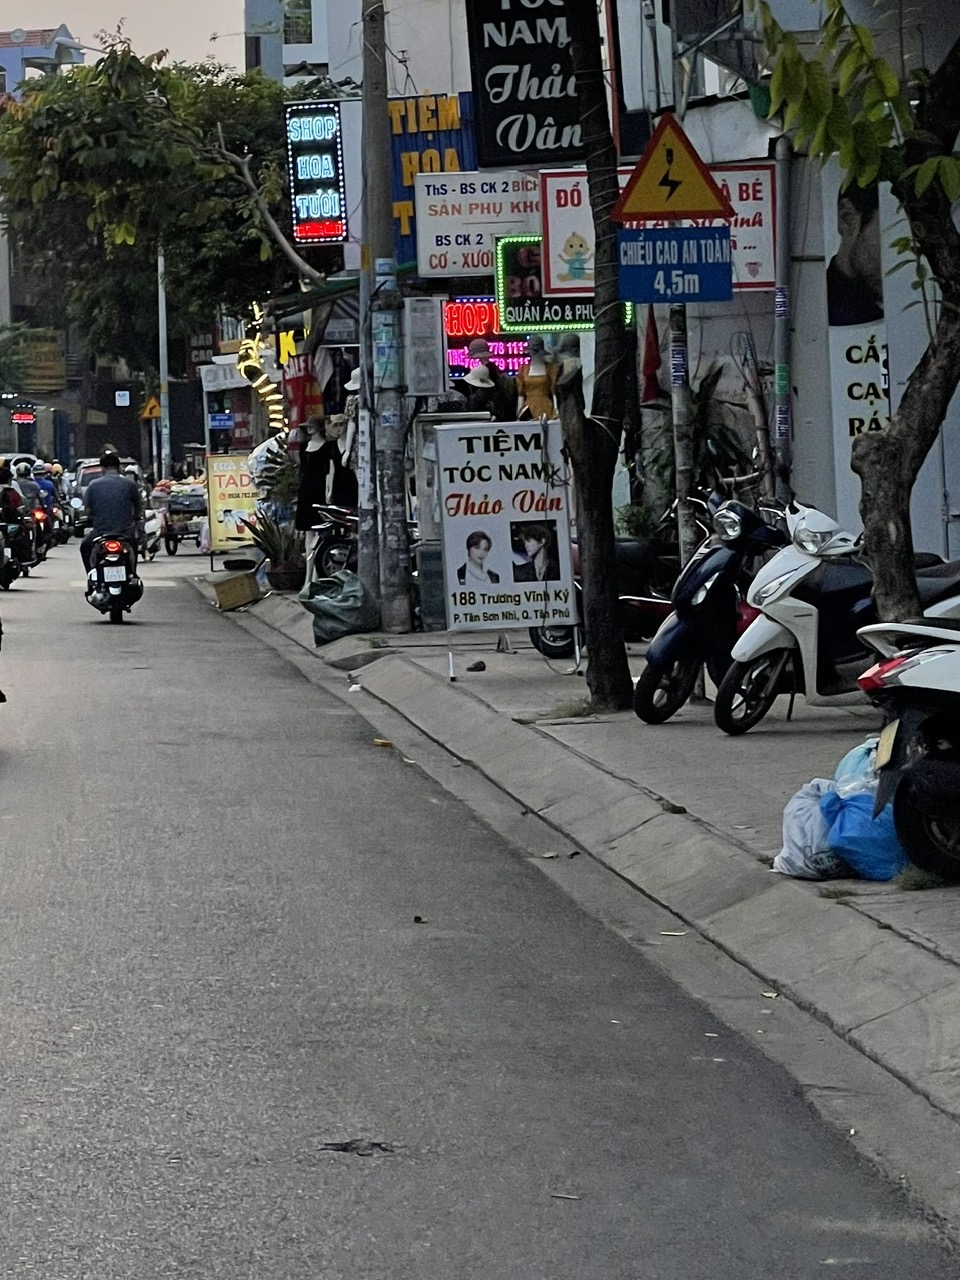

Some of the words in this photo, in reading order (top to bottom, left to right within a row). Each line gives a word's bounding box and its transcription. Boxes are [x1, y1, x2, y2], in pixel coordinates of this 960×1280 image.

[483, 17, 568, 48] NAM
[290, 116, 337, 142] SHOP
[496, 113, 583, 152] Vân
[296, 154, 335, 180] HOA
[425, 183, 448, 196] ThS
[460, 182, 476, 195] BS
[481, 181, 497, 194] CK
[501, 181, 510, 193] 2
[738, 178, 763, 202] BÉ
[295, 188, 341, 219] TƯƠI
[469, 202, 503, 218] PHỤ
[510, 200, 540, 214] KHO
[435, 235, 452, 247] BS
[455, 234, 471, 246] CK
[476, 233, 484, 245] 2
[620, 232, 653, 266] CHIỀU
[655, 240, 679, 266] CAO
[682, 240, 698, 264] AN
[701, 233, 731, 264] TOÀN
[462, 249, 495, 269] XƯƠ
[654, 269, 700, 298] 4,5m
[444, 302, 490, 336] HOP
[505, 299, 540, 322] QUẦN
[542, 299, 562, 321] ÁO
[847, 382, 890, 406] CẠ
[848, 410, 890, 437] RÁ
[458, 428, 543, 457] TIỆM
[443, 461, 492, 483] TÓC
[499, 462, 550, 481] NAM
[444, 492, 504, 517] Thảo
[512, 490, 564, 514] Vân
[451, 591, 476, 606] 188
[524, 590, 550, 603] Vĩnh
[554, 589, 570, 605] Ký
[453, 613, 462, 623] P.
[521, 609, 532, 620] Q.
[552, 606, 570, 619] Phú
